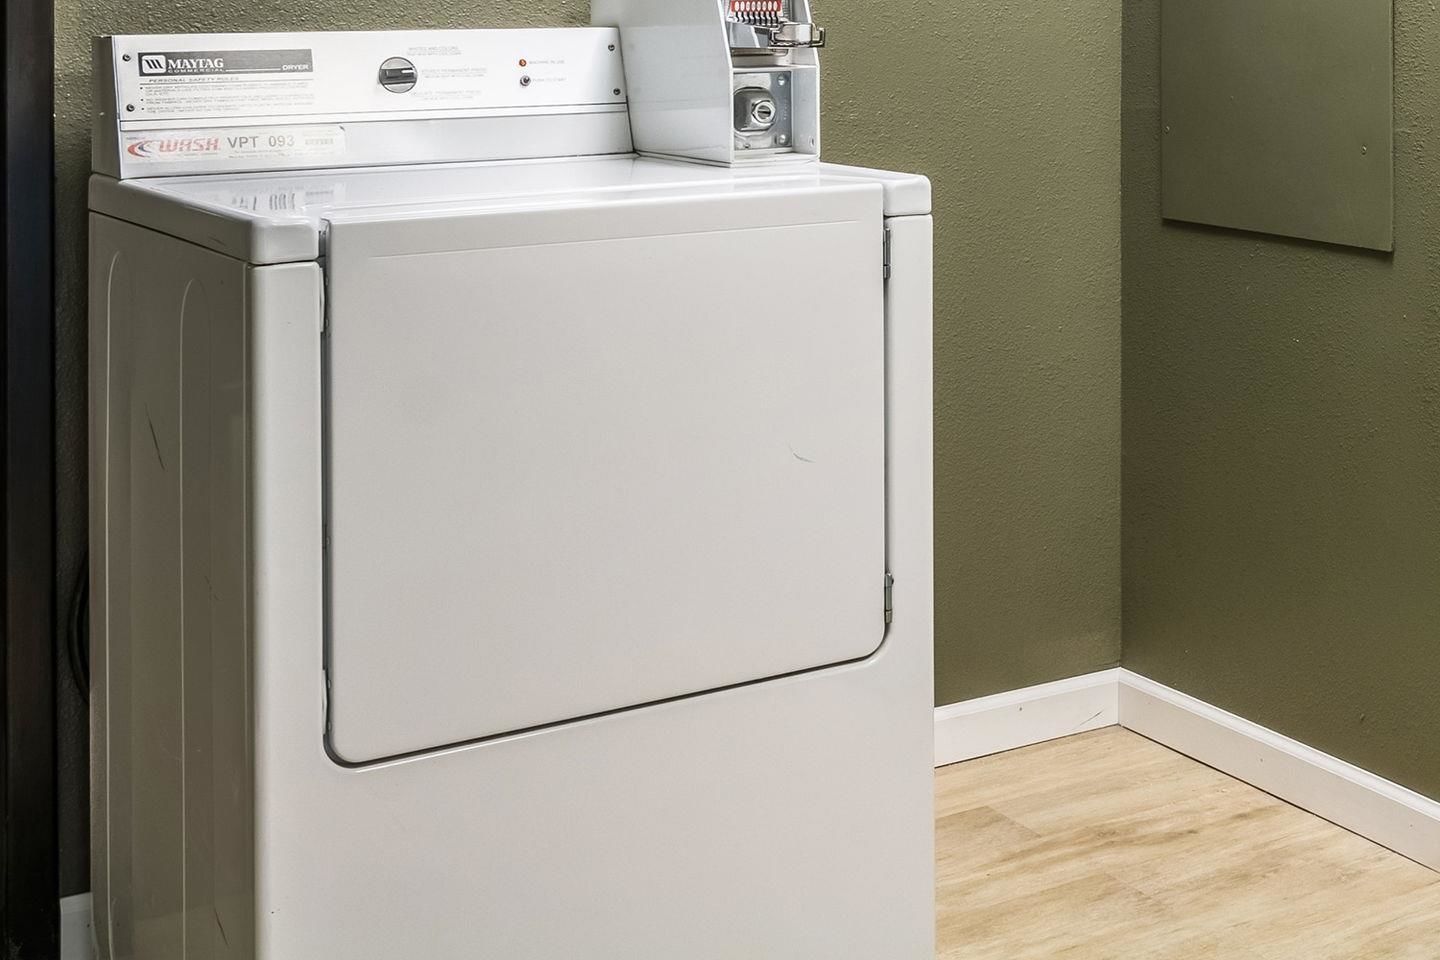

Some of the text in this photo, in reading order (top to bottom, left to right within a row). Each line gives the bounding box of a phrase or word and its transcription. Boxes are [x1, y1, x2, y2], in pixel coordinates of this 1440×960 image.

[167, 58, 224, 70] MAYTAG
[159, 135, 295, 153] WASH VPT 093
